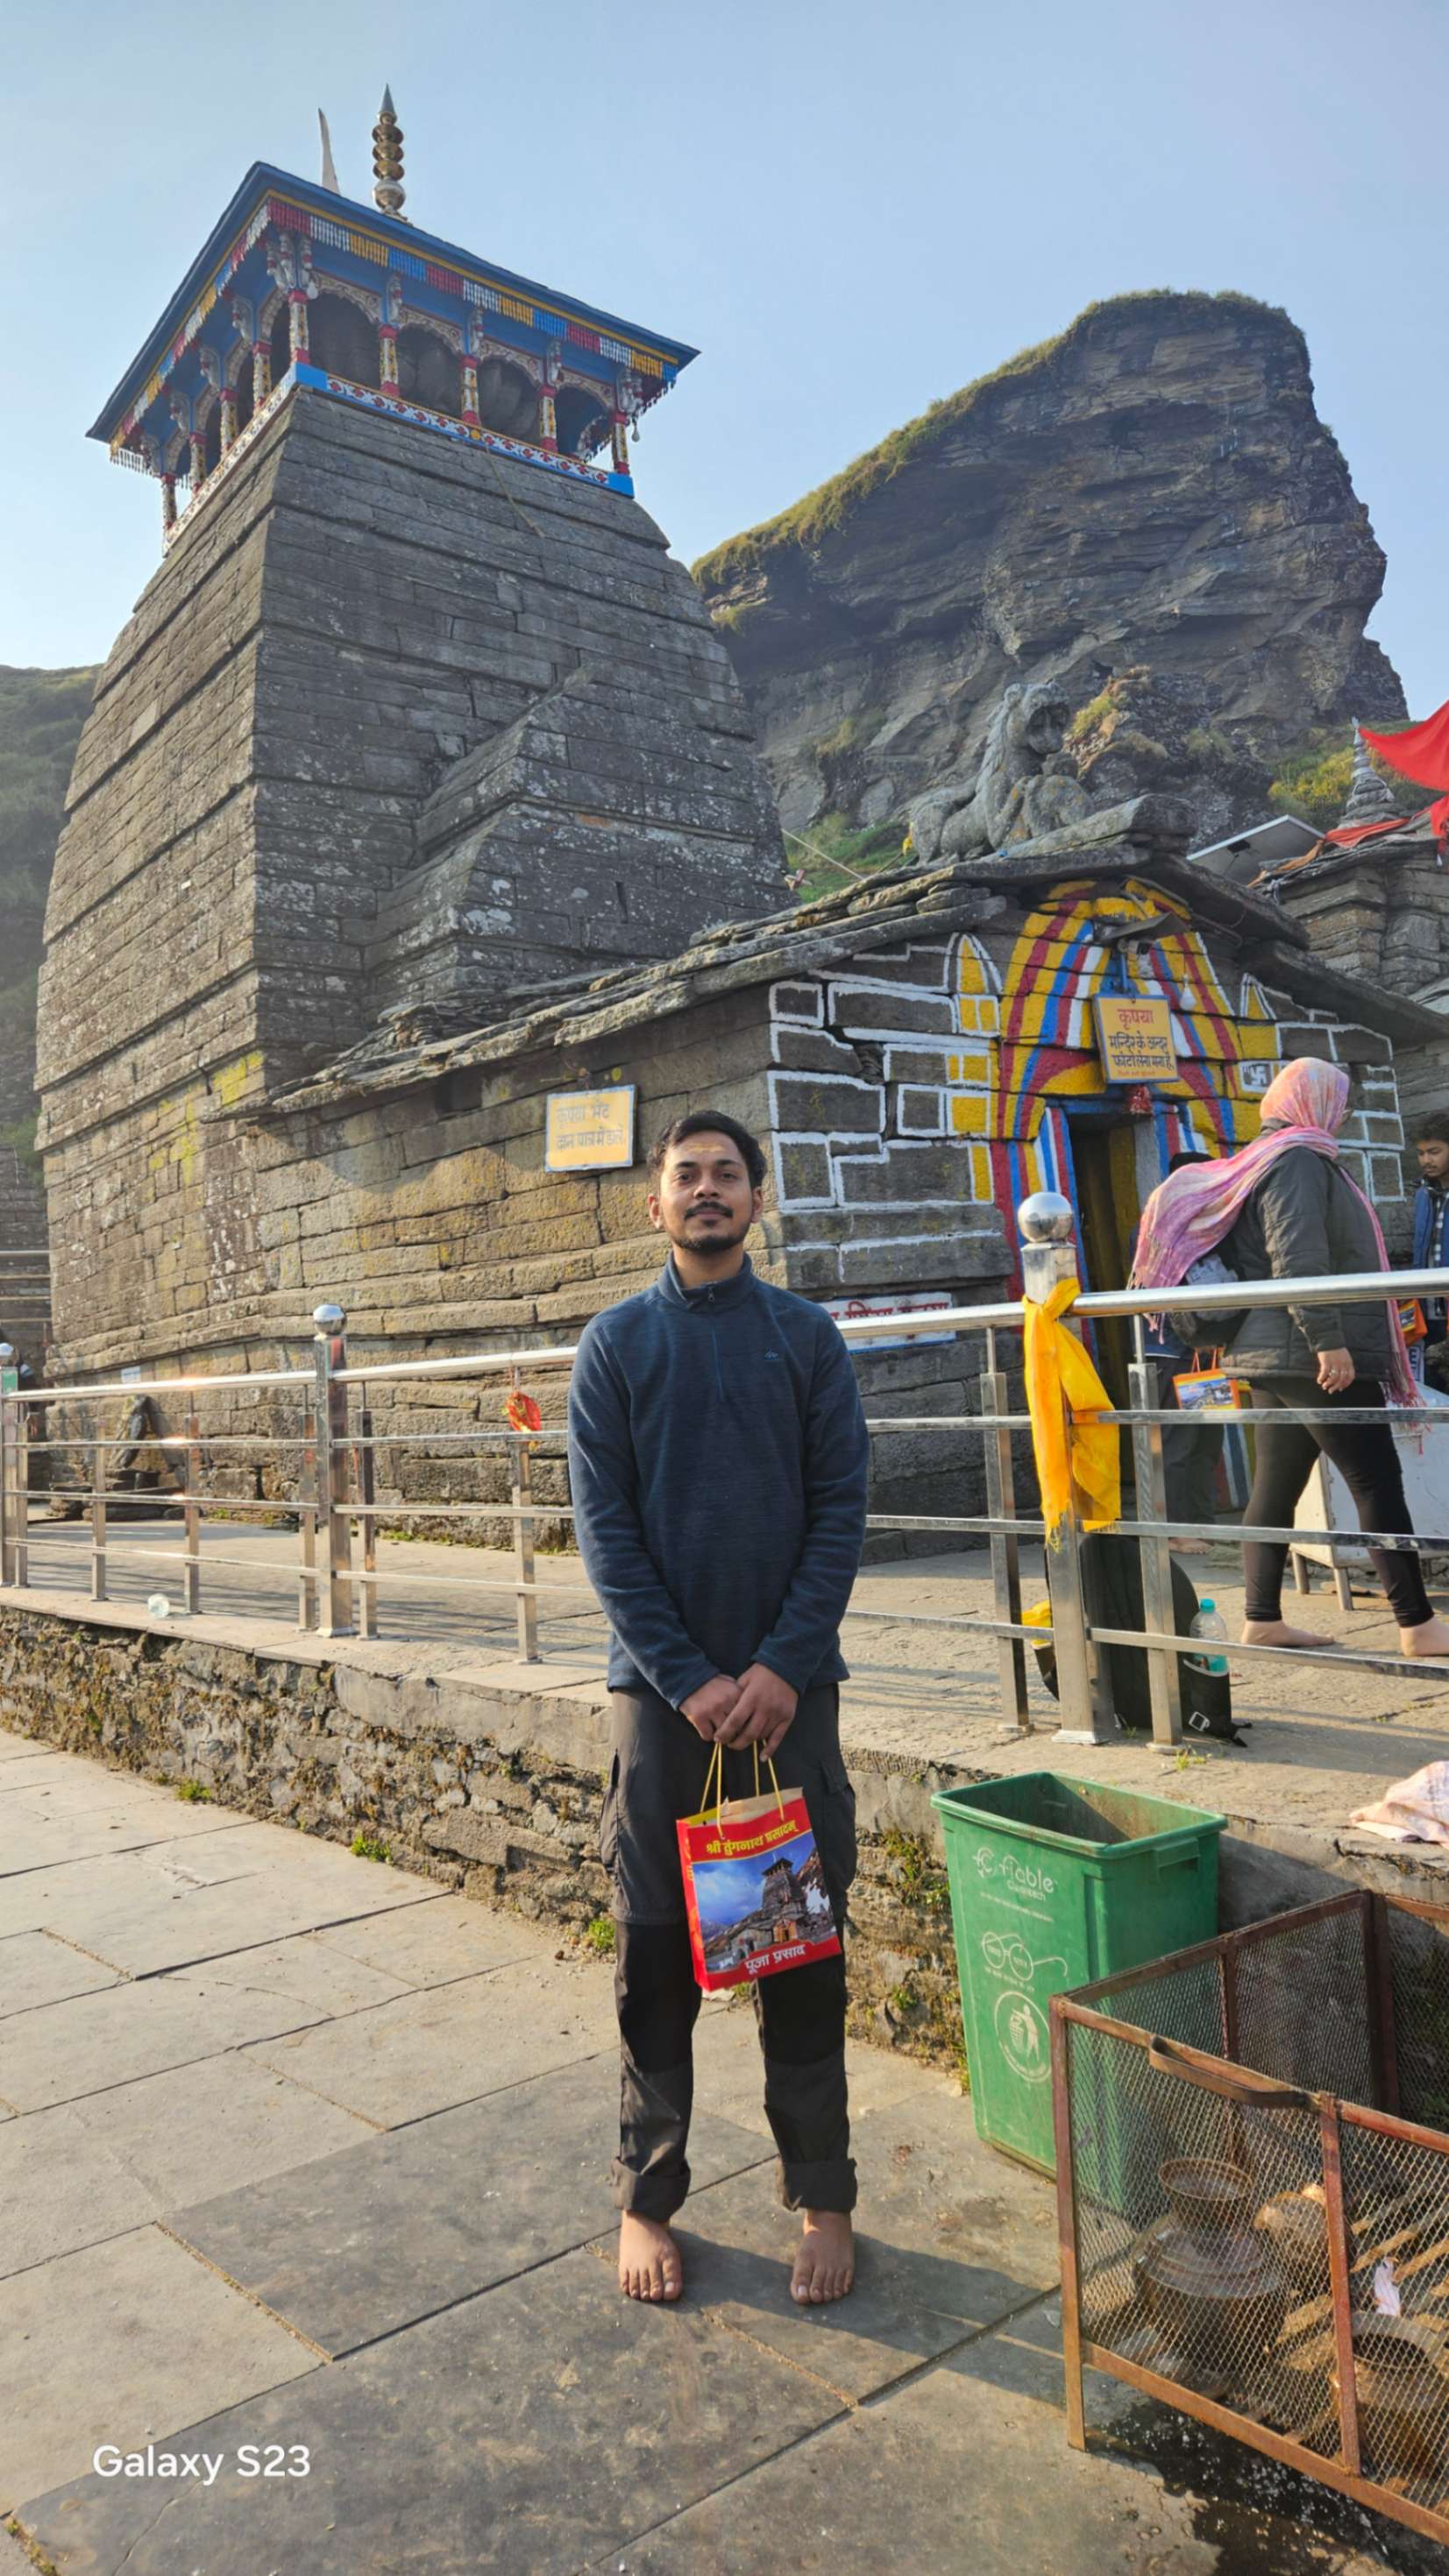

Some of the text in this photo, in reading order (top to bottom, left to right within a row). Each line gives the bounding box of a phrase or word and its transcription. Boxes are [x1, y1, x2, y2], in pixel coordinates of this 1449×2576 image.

[1117, 1009, 1154, 1030] कृपया
[706, 1838, 721, 1854] श्री
[744, 1954, 771, 1975] पूजा
